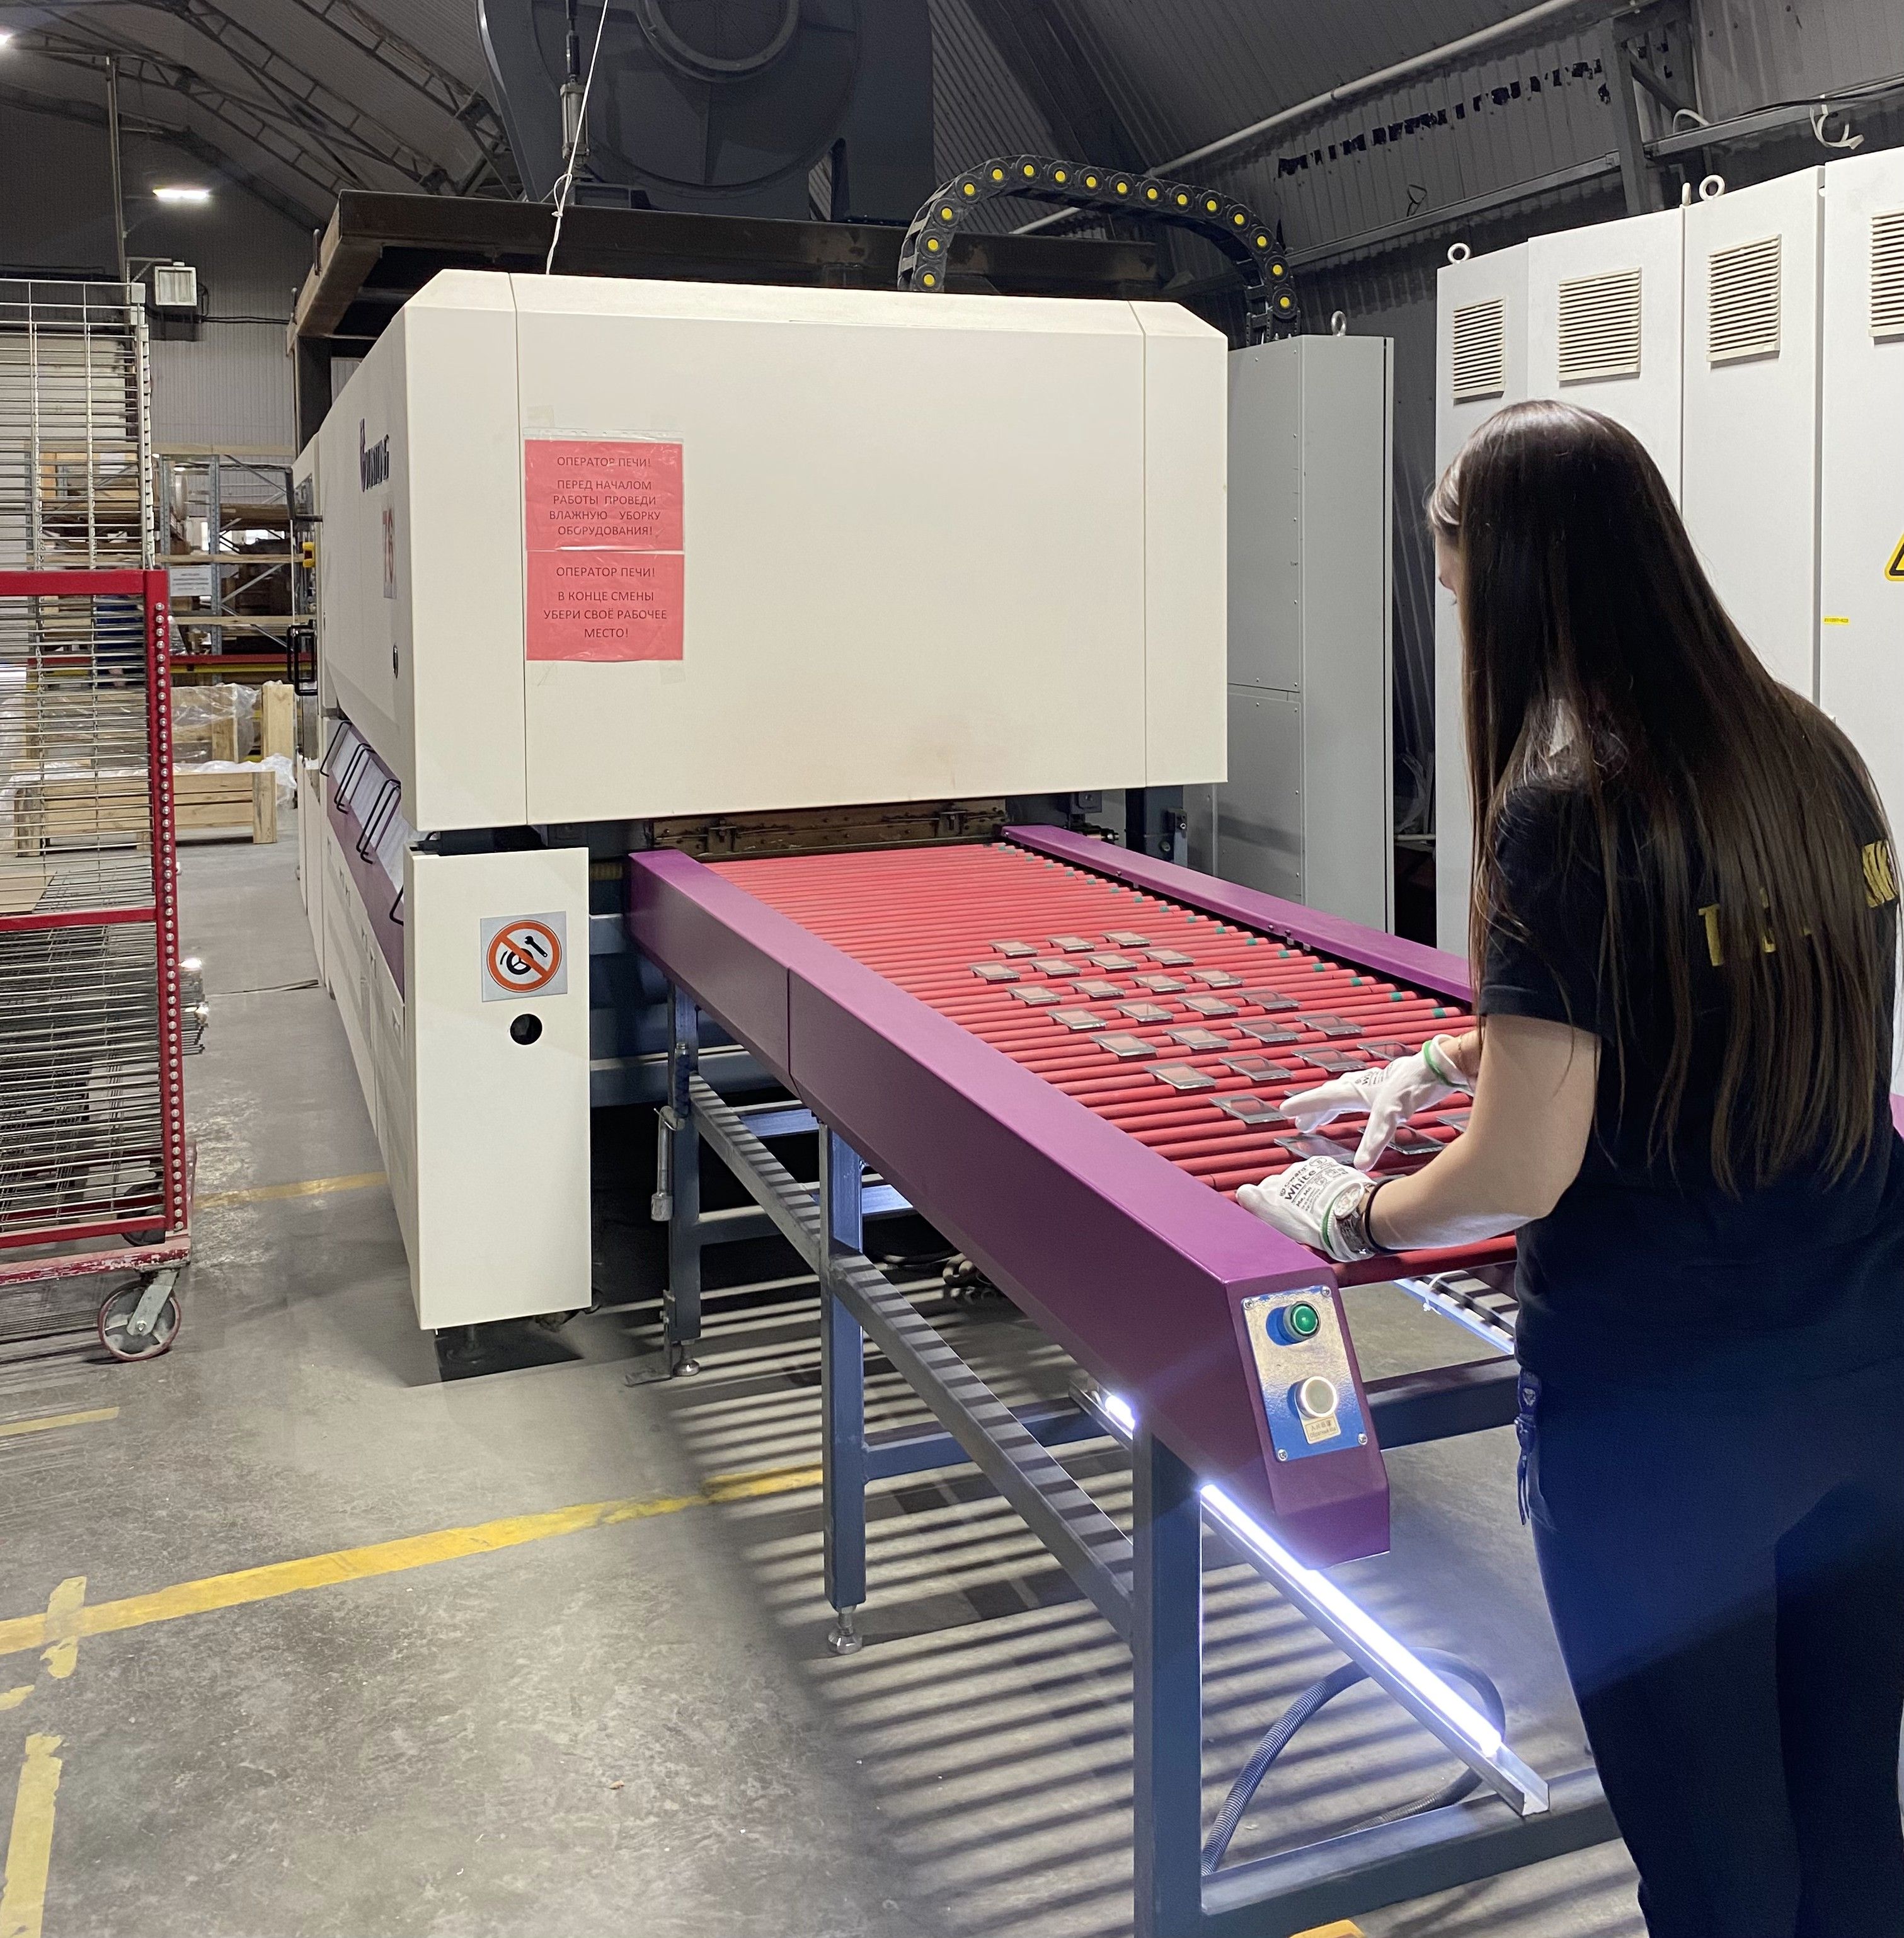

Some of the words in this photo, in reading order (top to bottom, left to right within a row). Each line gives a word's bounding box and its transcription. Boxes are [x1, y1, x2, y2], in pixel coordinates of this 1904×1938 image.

[558, 457, 614, 466] ОПЕРАТОР
[619, 458, 650, 467] ПЕЧИ!
[558, 480, 593, 491] ПЕРЕД
[597, 481, 651, 490] НАЧАЛОМ
[554, 495, 598, 504] РАБОТЫ
[605, 496, 655, 507] ПРОВЕДИ
[550, 511, 607, 520] ВЛАЖНУЮ
[619, 511, 660, 520] УБОРКУ
[558, 526, 651, 537] ОБОРУДОВАНИЯ!
[556, 567, 617, 576] ОПЕРАТОР
[621, 568, 655, 577] ПЕЧИ!
[558, 592, 565, 600] В
[569, 592, 607, 603] КОНЦЕ
[611, 592, 653, 601] СМЕНЫ
[544, 610, 580, 619] УБЕРИ
[584, 608, 613, 619] СВОЁ
[617, 610, 667, 619] РАБОЧЕЕ
[585, 628, 628, 638] МЕСТО!
[1285, 1170, 1316, 1200] White
